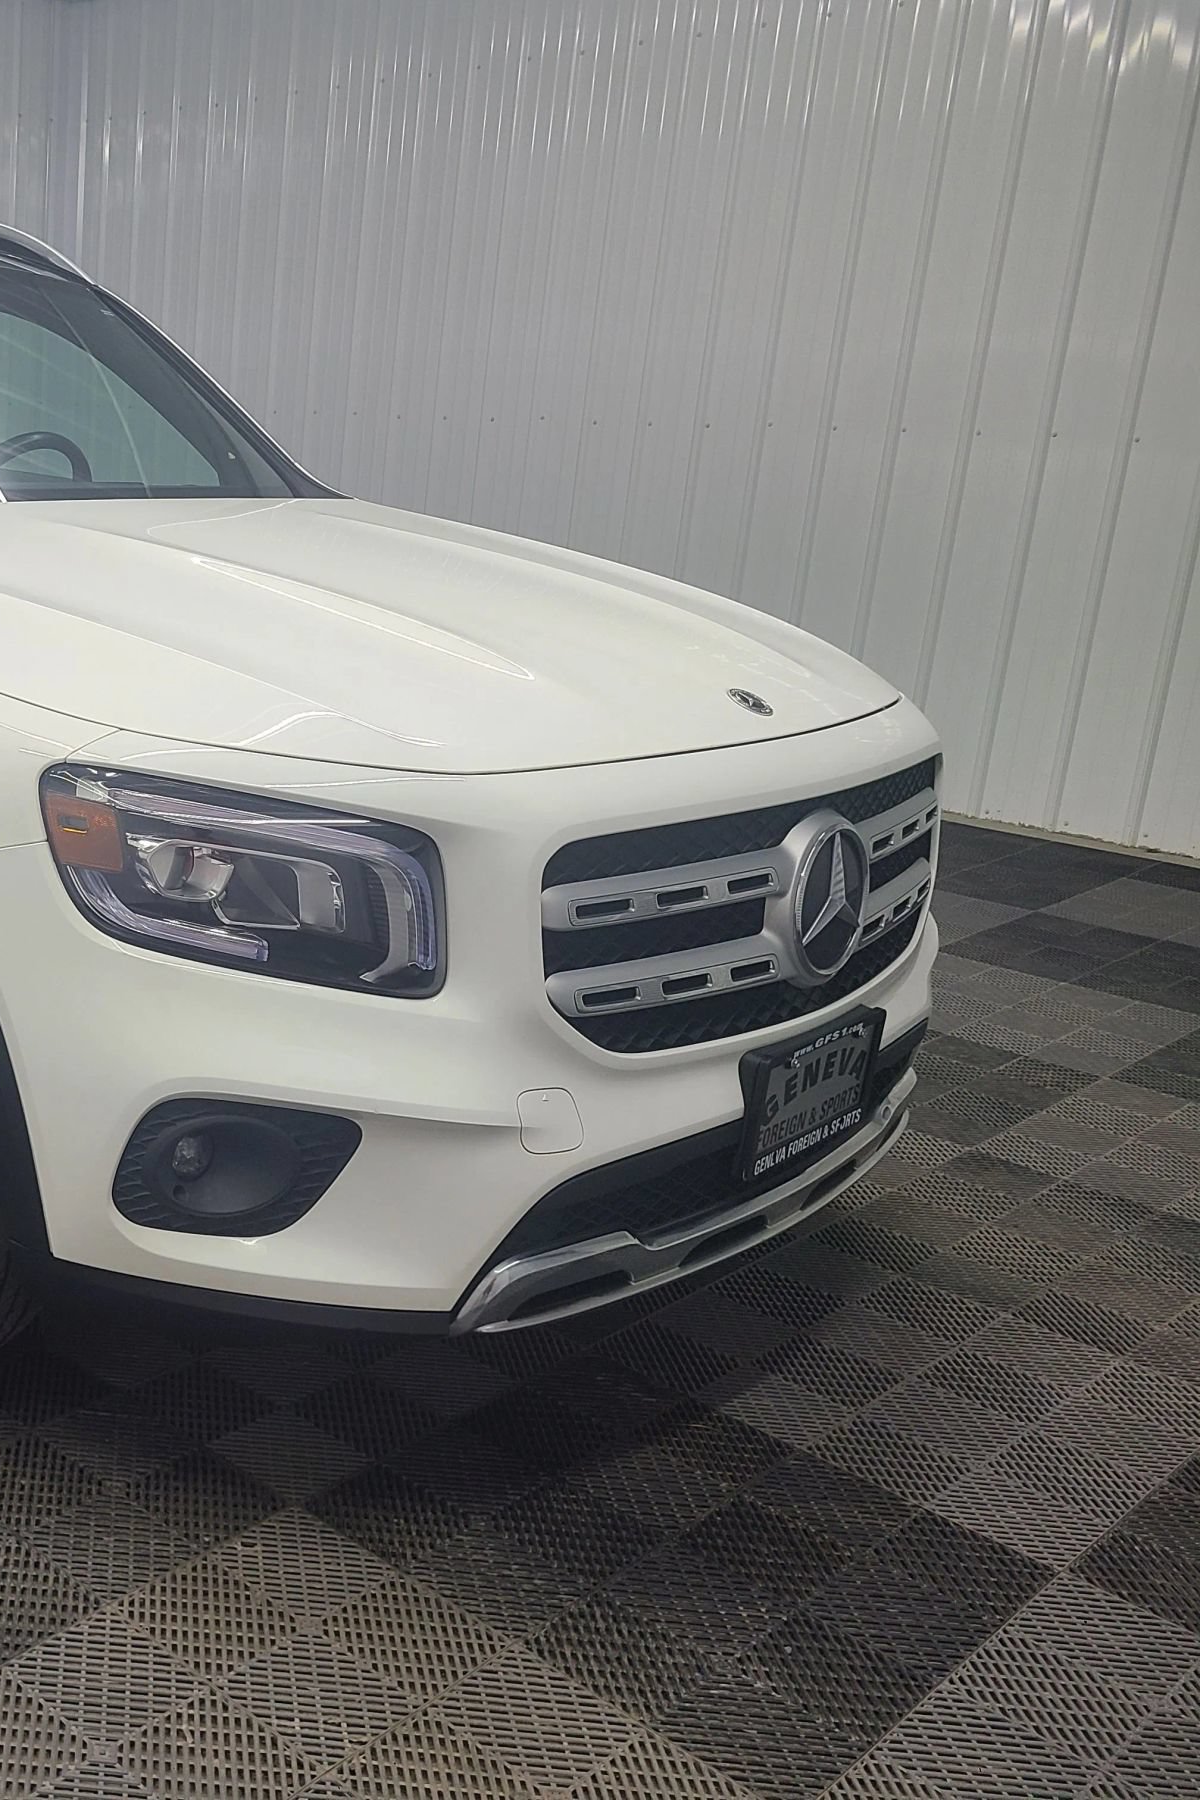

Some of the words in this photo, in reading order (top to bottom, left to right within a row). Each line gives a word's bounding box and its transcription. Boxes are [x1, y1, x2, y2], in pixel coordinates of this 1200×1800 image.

[757, 1114, 807, 1147] FOREIGN
[808, 1110, 816, 1124] &
[819, 1084, 861, 1120] SPORTS
[765, 1047, 867, 1121] GENEVA
[787, 1130, 821, 1159] FOREIGN
[822, 1126, 829, 1139] &
